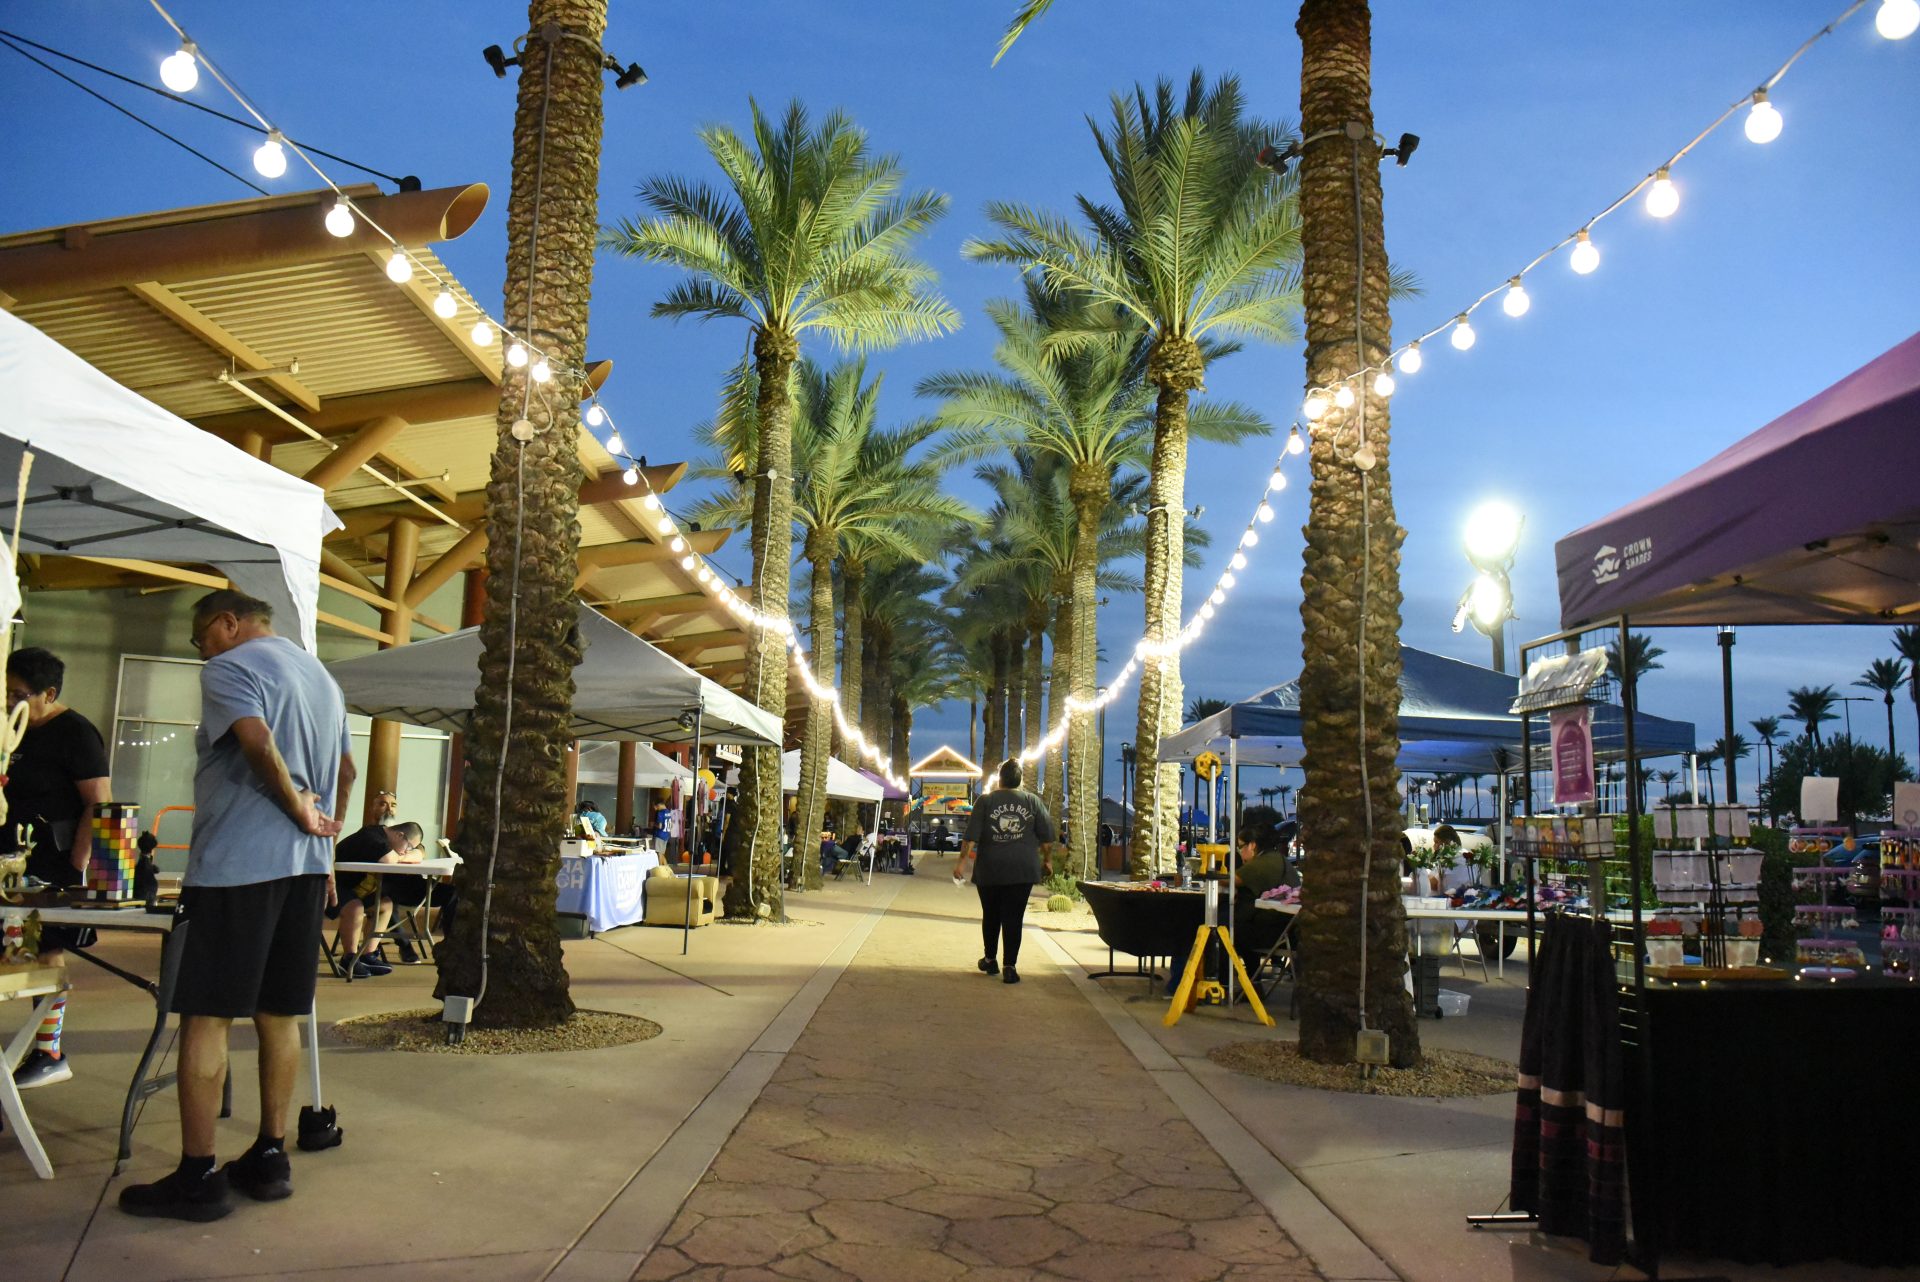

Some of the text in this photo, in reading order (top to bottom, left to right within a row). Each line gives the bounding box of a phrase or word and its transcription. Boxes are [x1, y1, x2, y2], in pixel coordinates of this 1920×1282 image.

[1623, 536, 1652, 558] CROWN
[1625, 551, 1652, 570] SHADES
[990, 803, 1033, 821] ROCK & ROLL
